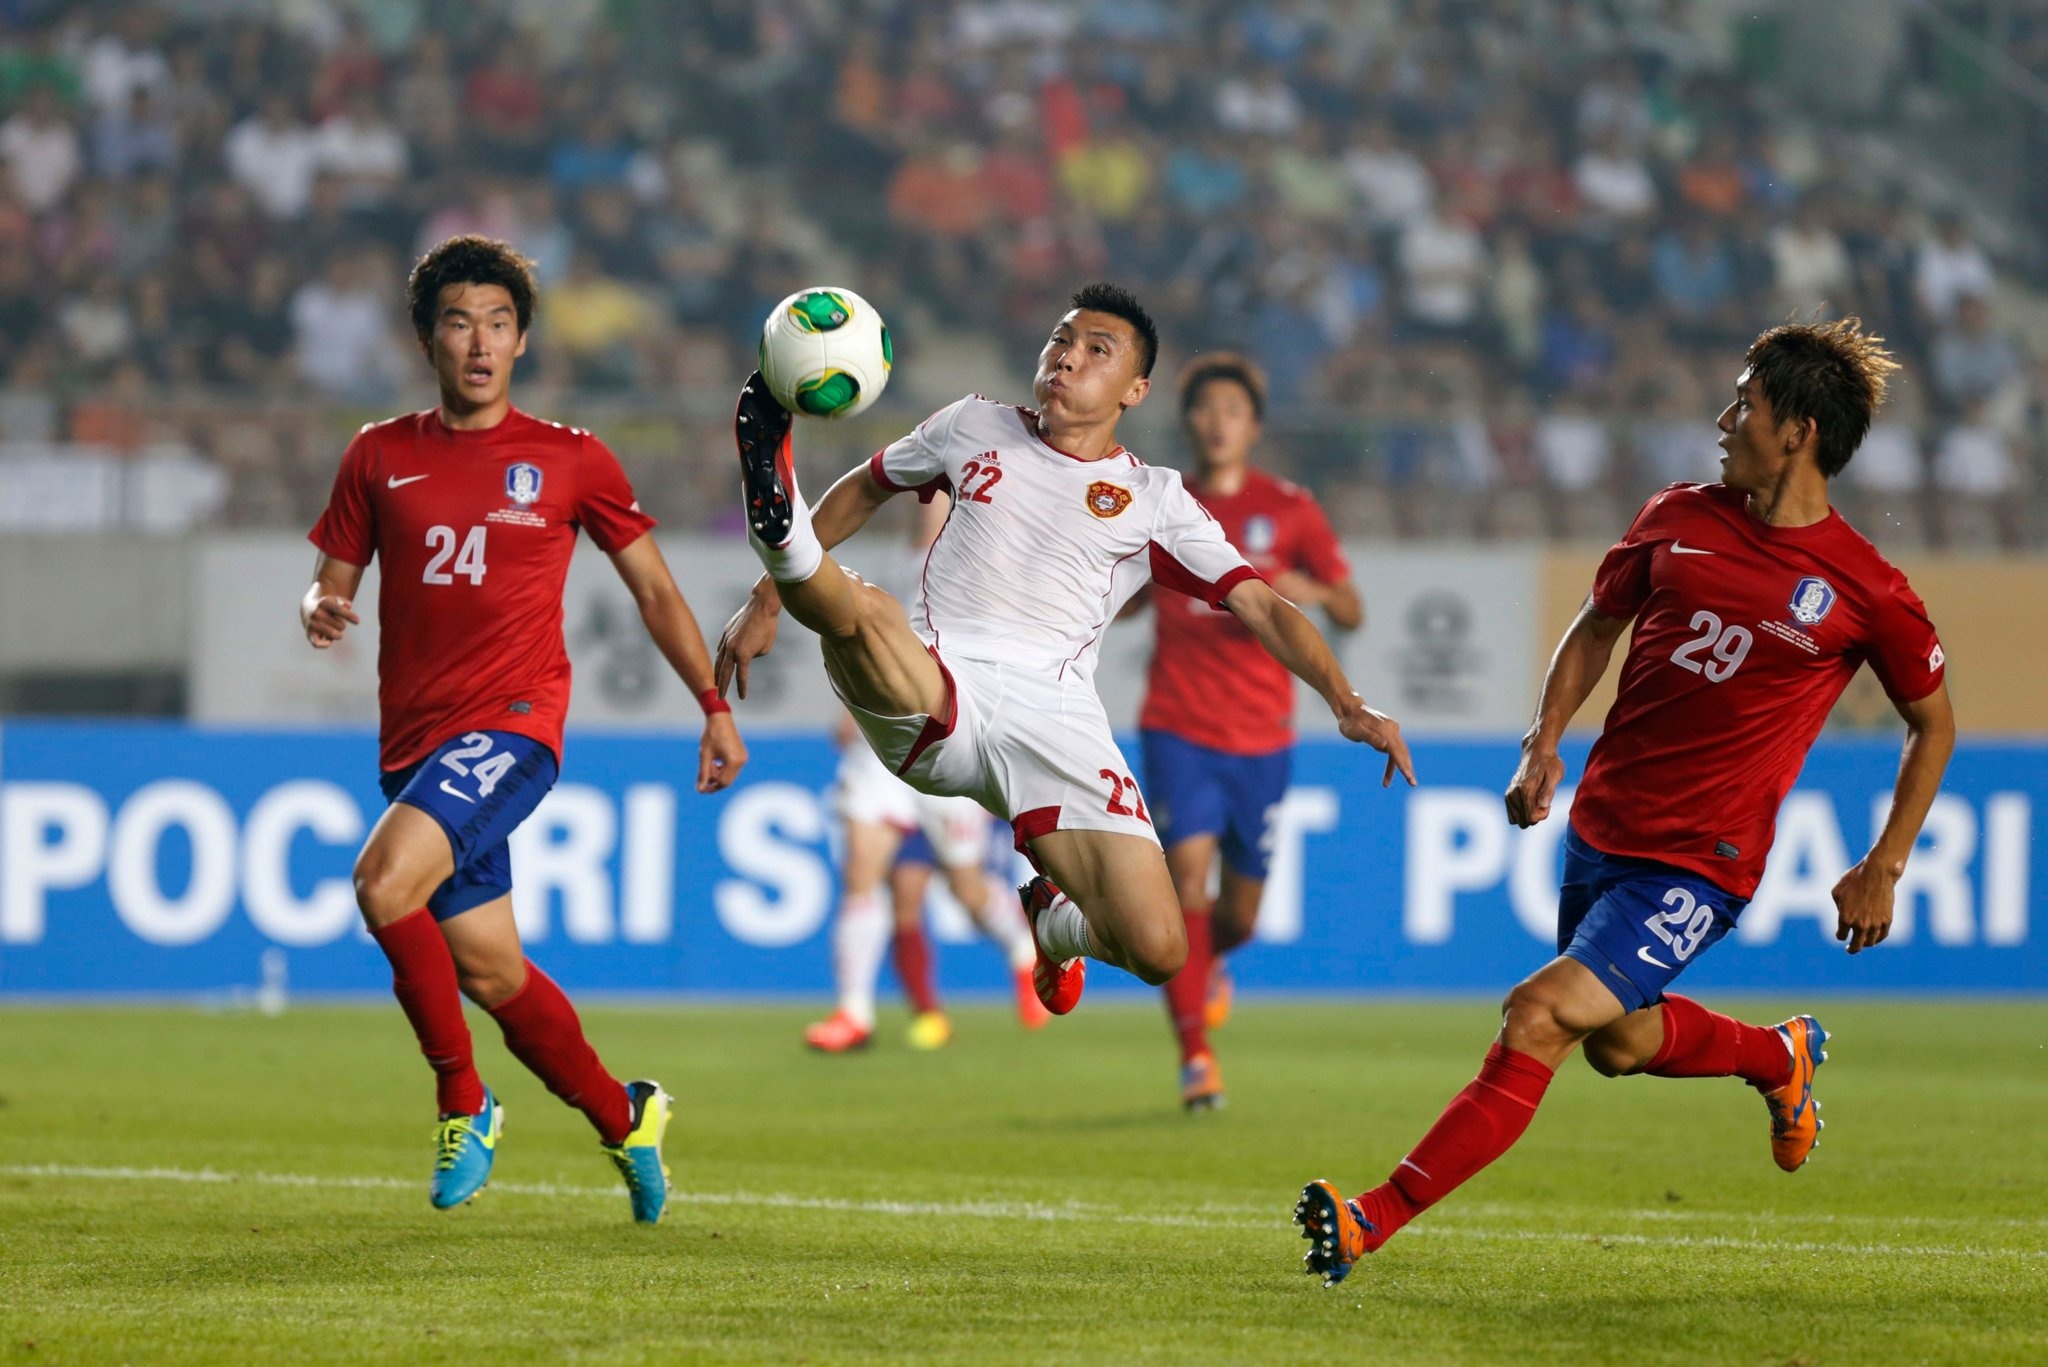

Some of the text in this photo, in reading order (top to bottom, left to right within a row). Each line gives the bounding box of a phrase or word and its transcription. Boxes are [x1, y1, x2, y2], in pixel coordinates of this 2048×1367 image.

[958, 461, 1003, 505] 22
[971, 455, 1001, 466] adidas
[422, 525, 488, 586] 24
[1670, 610, 1753, 683] 29
[439, 731, 516, 798] 24
[0, 777, 677, 948] POCRI
[1405, 786, 2033, 948] PARI
[1644, 887, 1714, 961] 29
